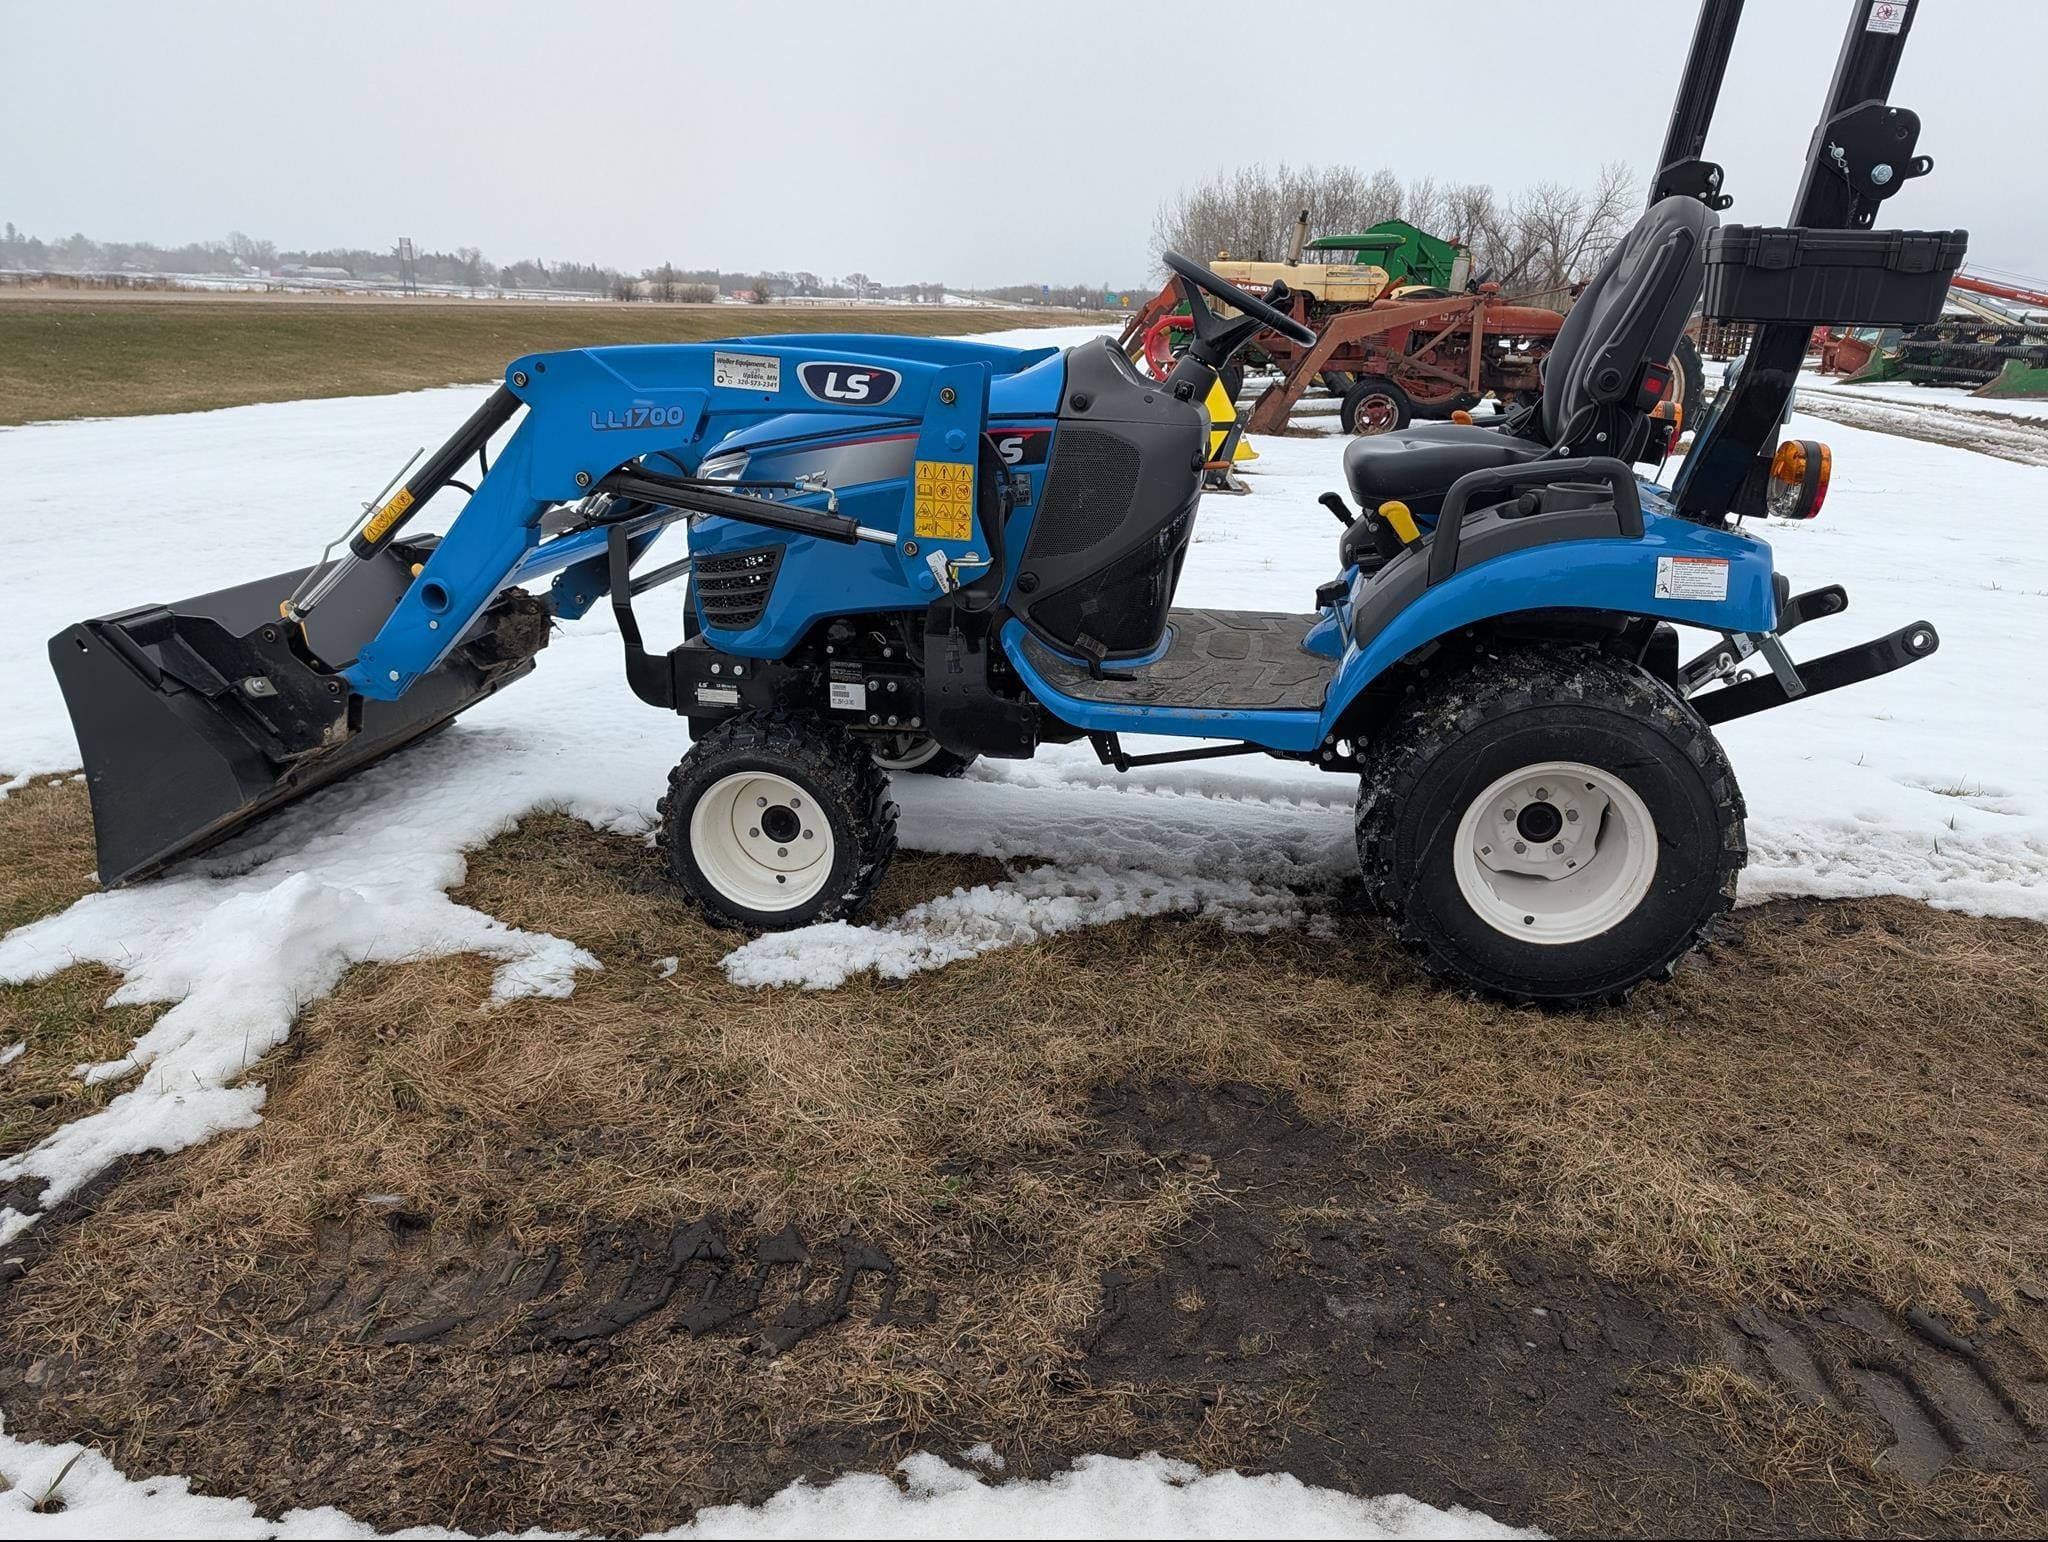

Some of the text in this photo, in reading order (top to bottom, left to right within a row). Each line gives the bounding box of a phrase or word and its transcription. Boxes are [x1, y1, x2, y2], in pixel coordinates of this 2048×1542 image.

[737, 379, 777, 388] 320-573-2341
[824, 371, 871, 399] LS
[591, 406, 685, 430] LL1700
[999, 437, 1024, 464] S
